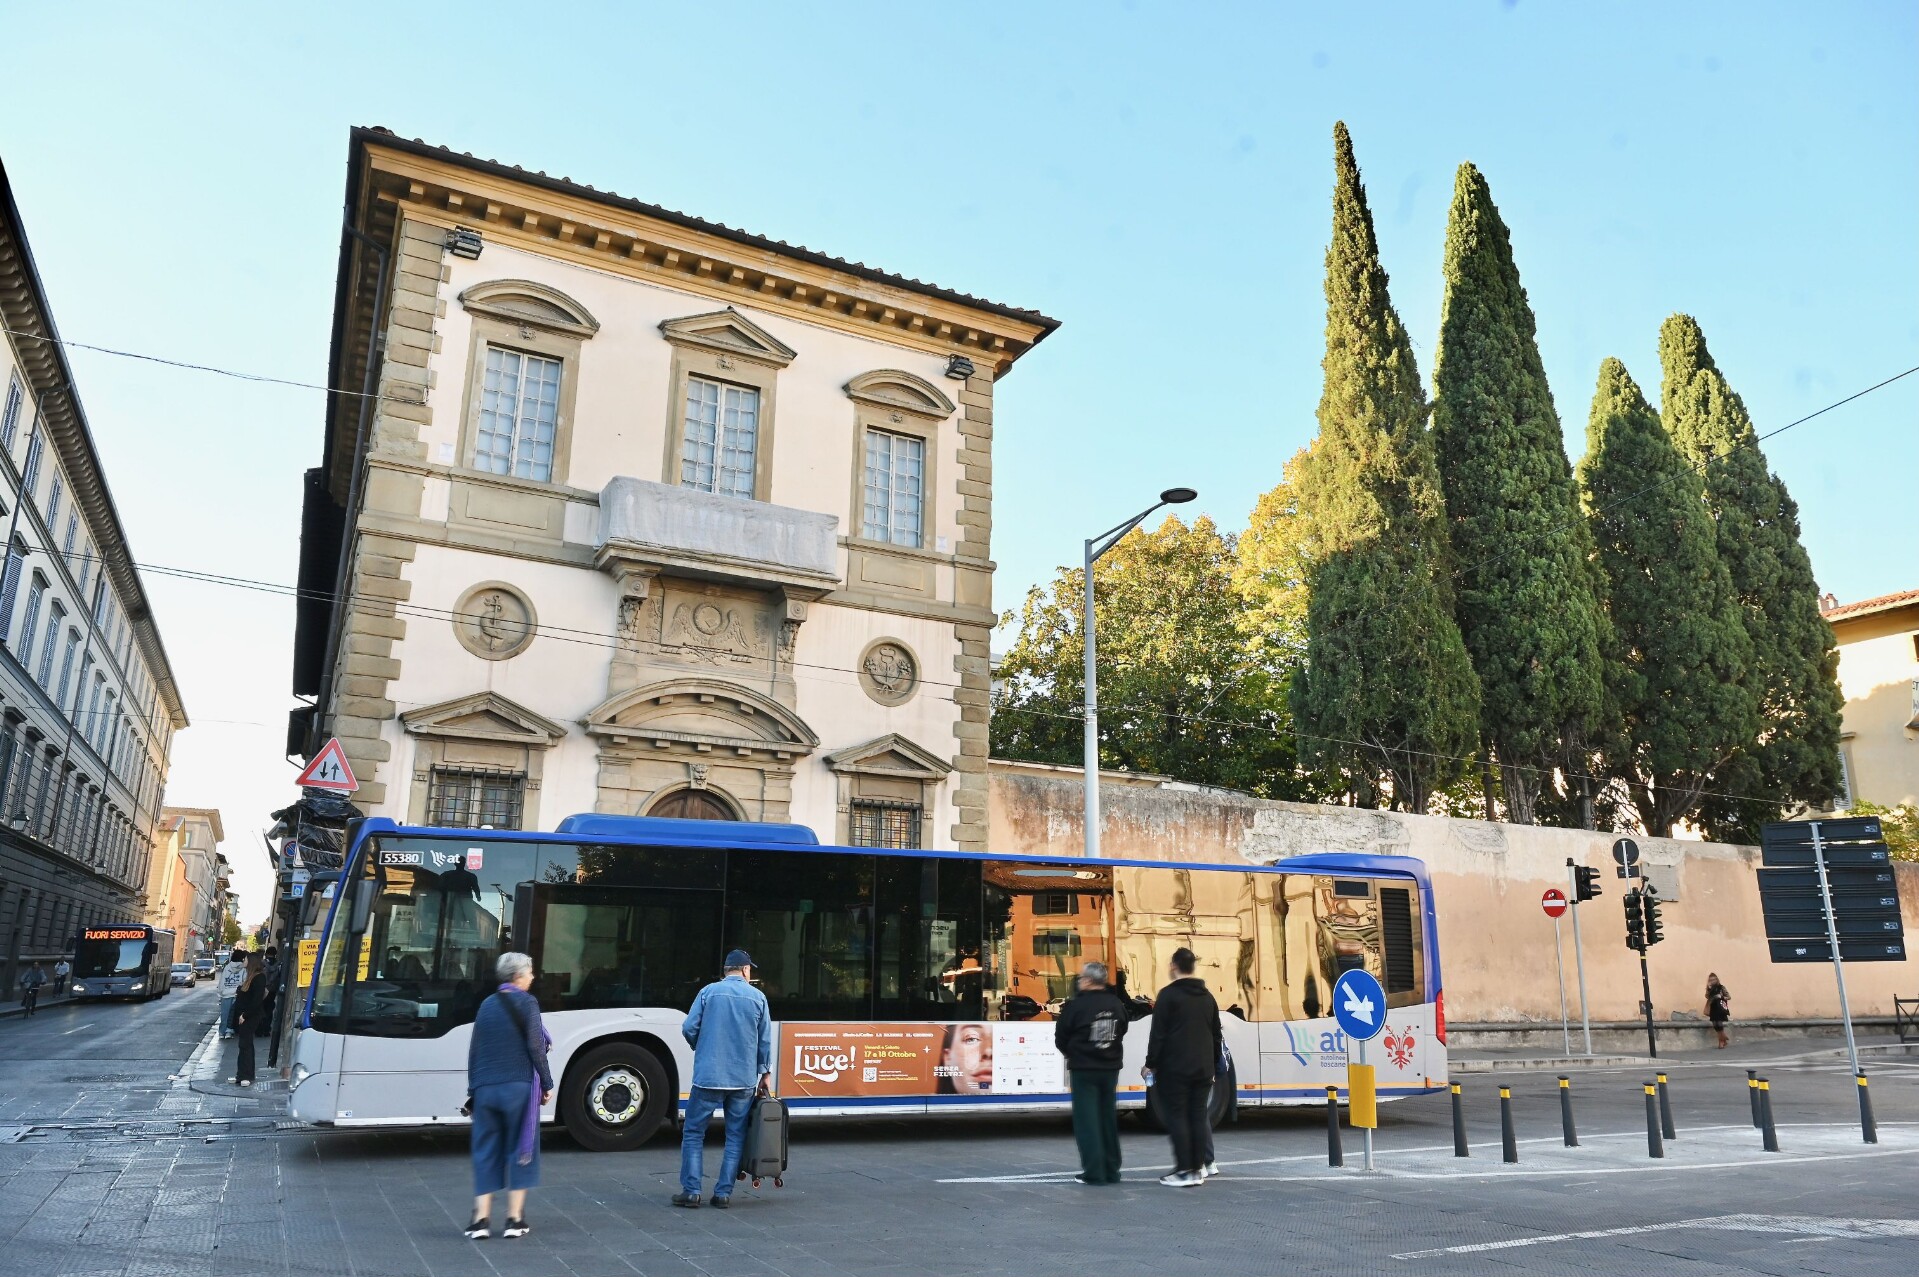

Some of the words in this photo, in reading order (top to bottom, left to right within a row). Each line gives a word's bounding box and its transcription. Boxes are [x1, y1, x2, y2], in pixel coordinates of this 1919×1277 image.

[384, 853, 420, 863] 55380
[447, 853, 461, 864] at
[85, 931, 109, 939] FUORI
[110, 931, 145, 939] SERVIZIO
[1320, 1028, 1346, 1053] at
[794, 1045, 857, 1083] Luce!
